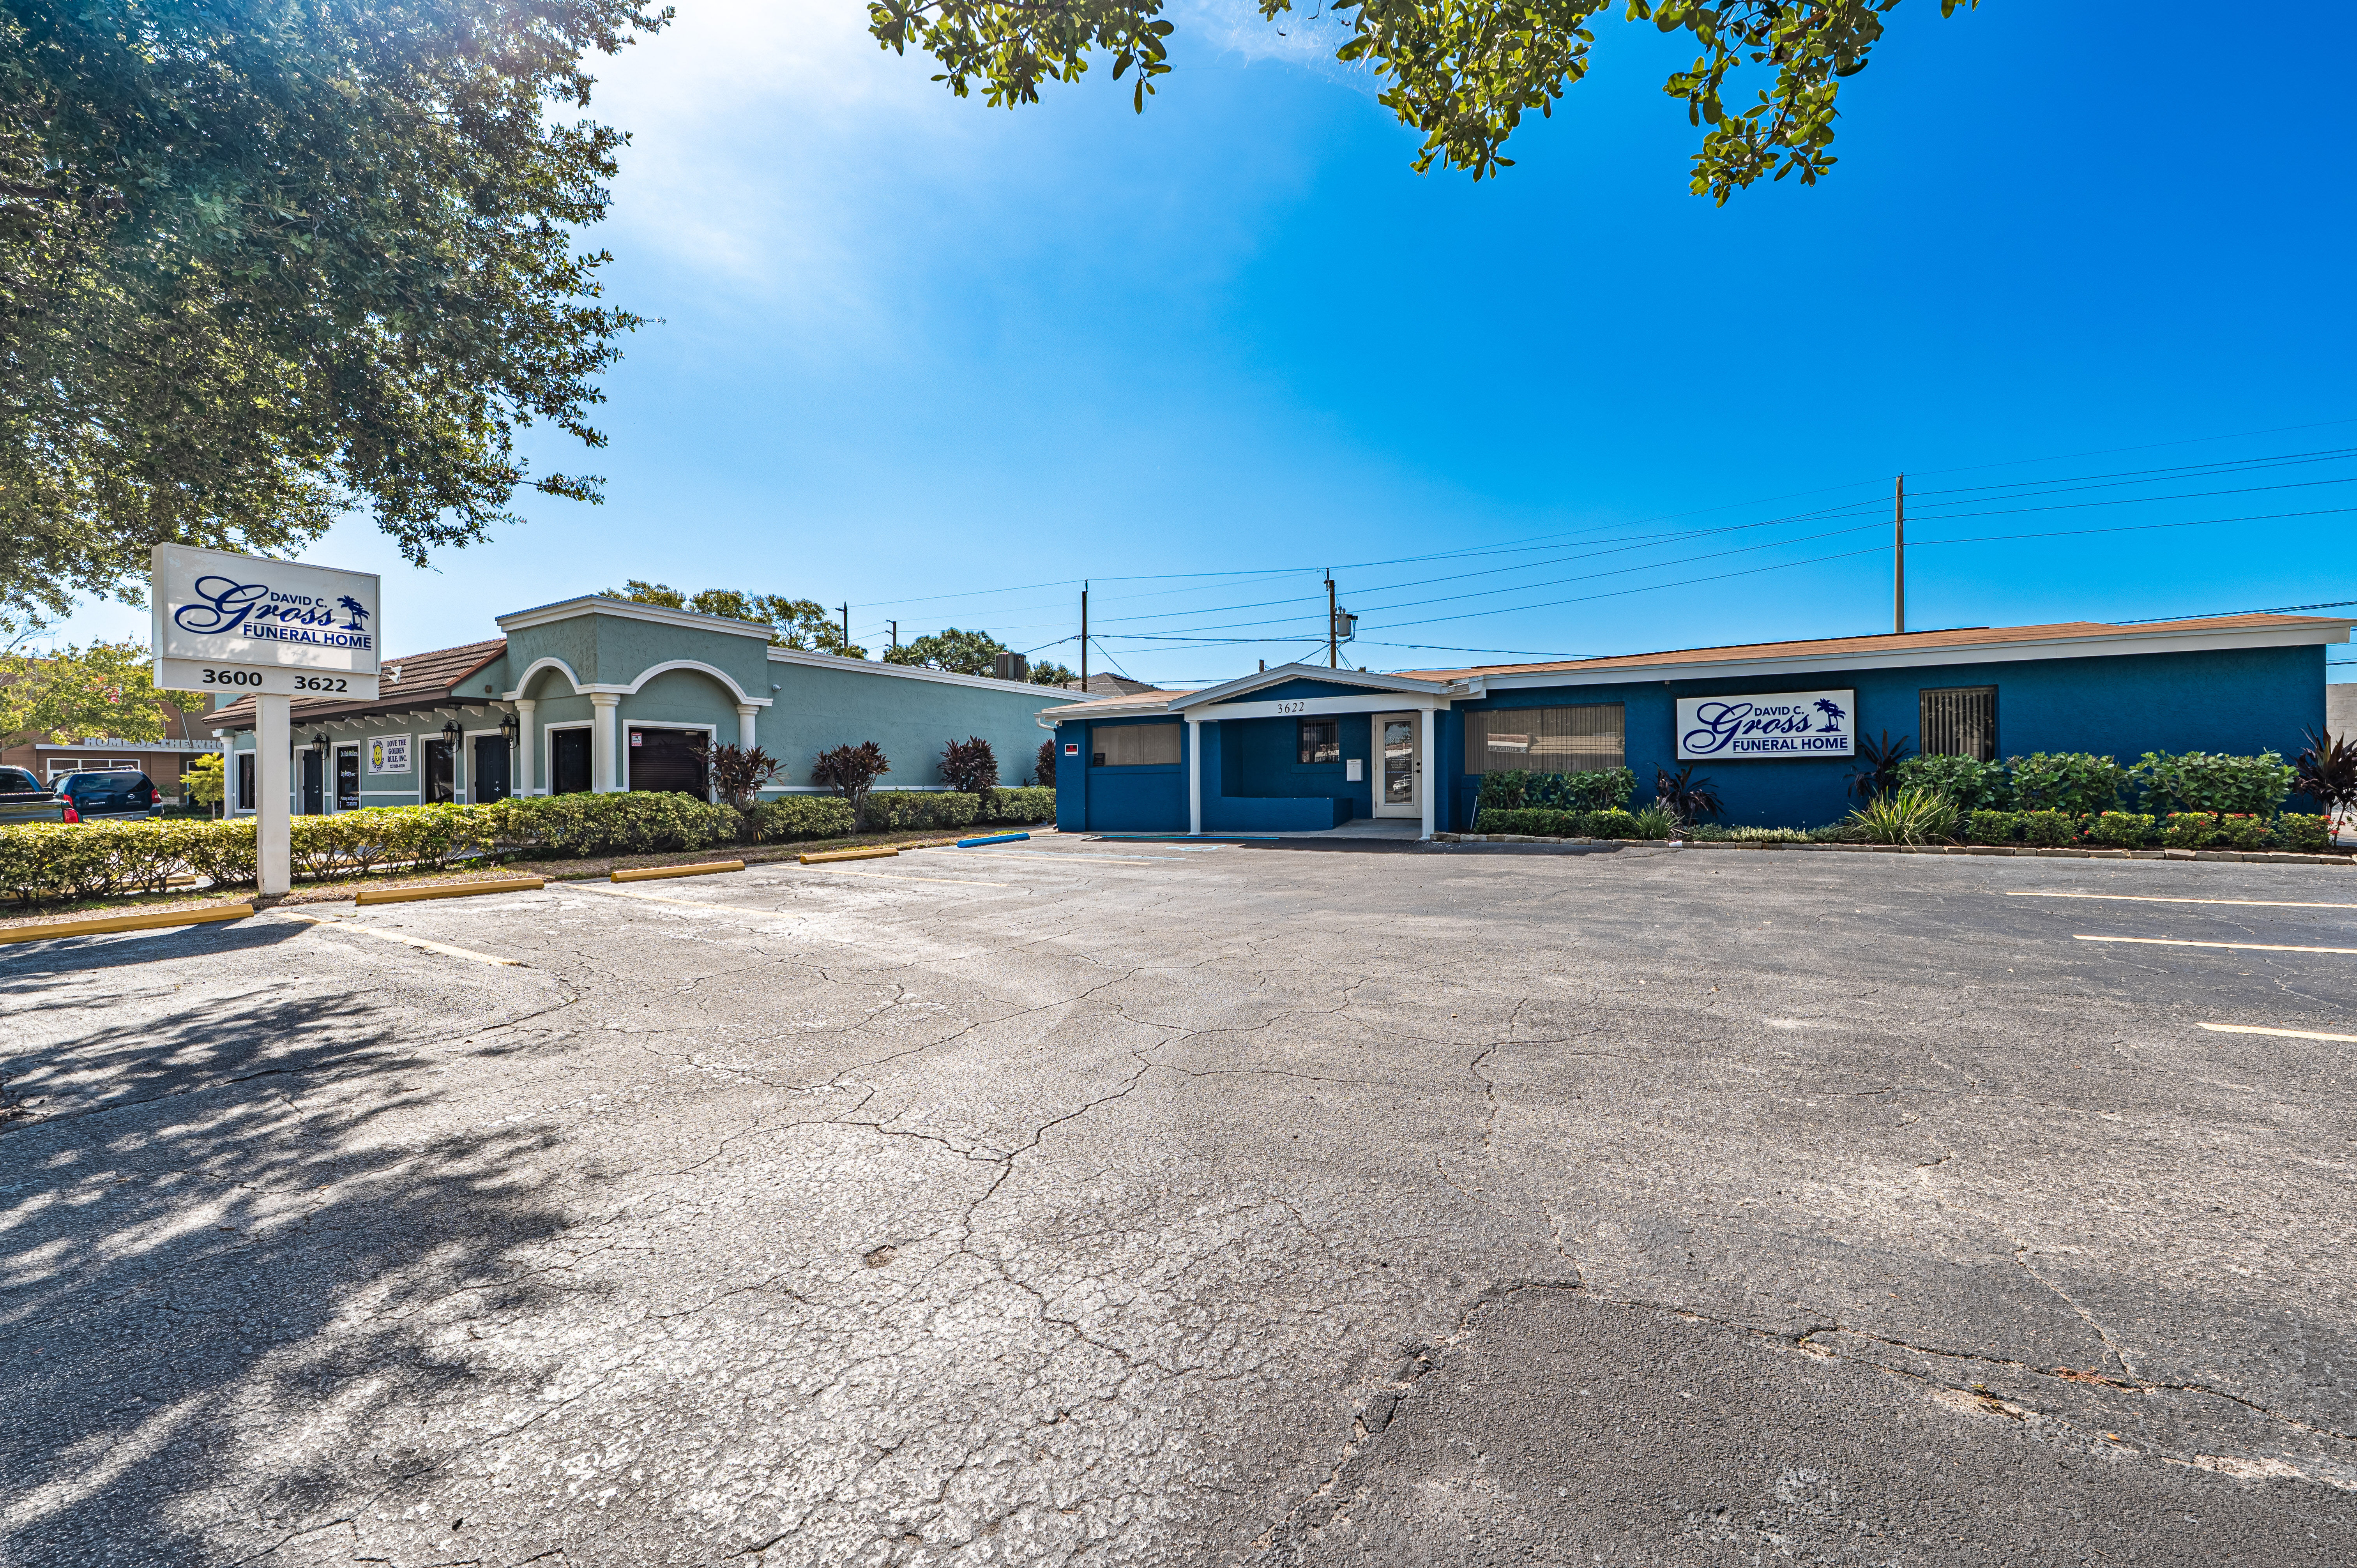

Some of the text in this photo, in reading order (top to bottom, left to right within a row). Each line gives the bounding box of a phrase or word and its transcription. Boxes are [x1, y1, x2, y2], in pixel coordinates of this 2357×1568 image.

[174, 576, 336, 634] Gross
[271, 592, 327, 608] DAVID C.
[244, 624, 372, 648] FUNERAL HOME
[202, 669, 263, 687] 3600
[294, 676, 348, 692] 3622
[1278, 701, 1304, 713] 3622
[1754, 706, 1804, 717] DAVID C.
[1683, 702, 1813, 754] Gross
[157, 739, 190, 748] THE
[1733, 737, 1848, 751] FUNERAL HOME
